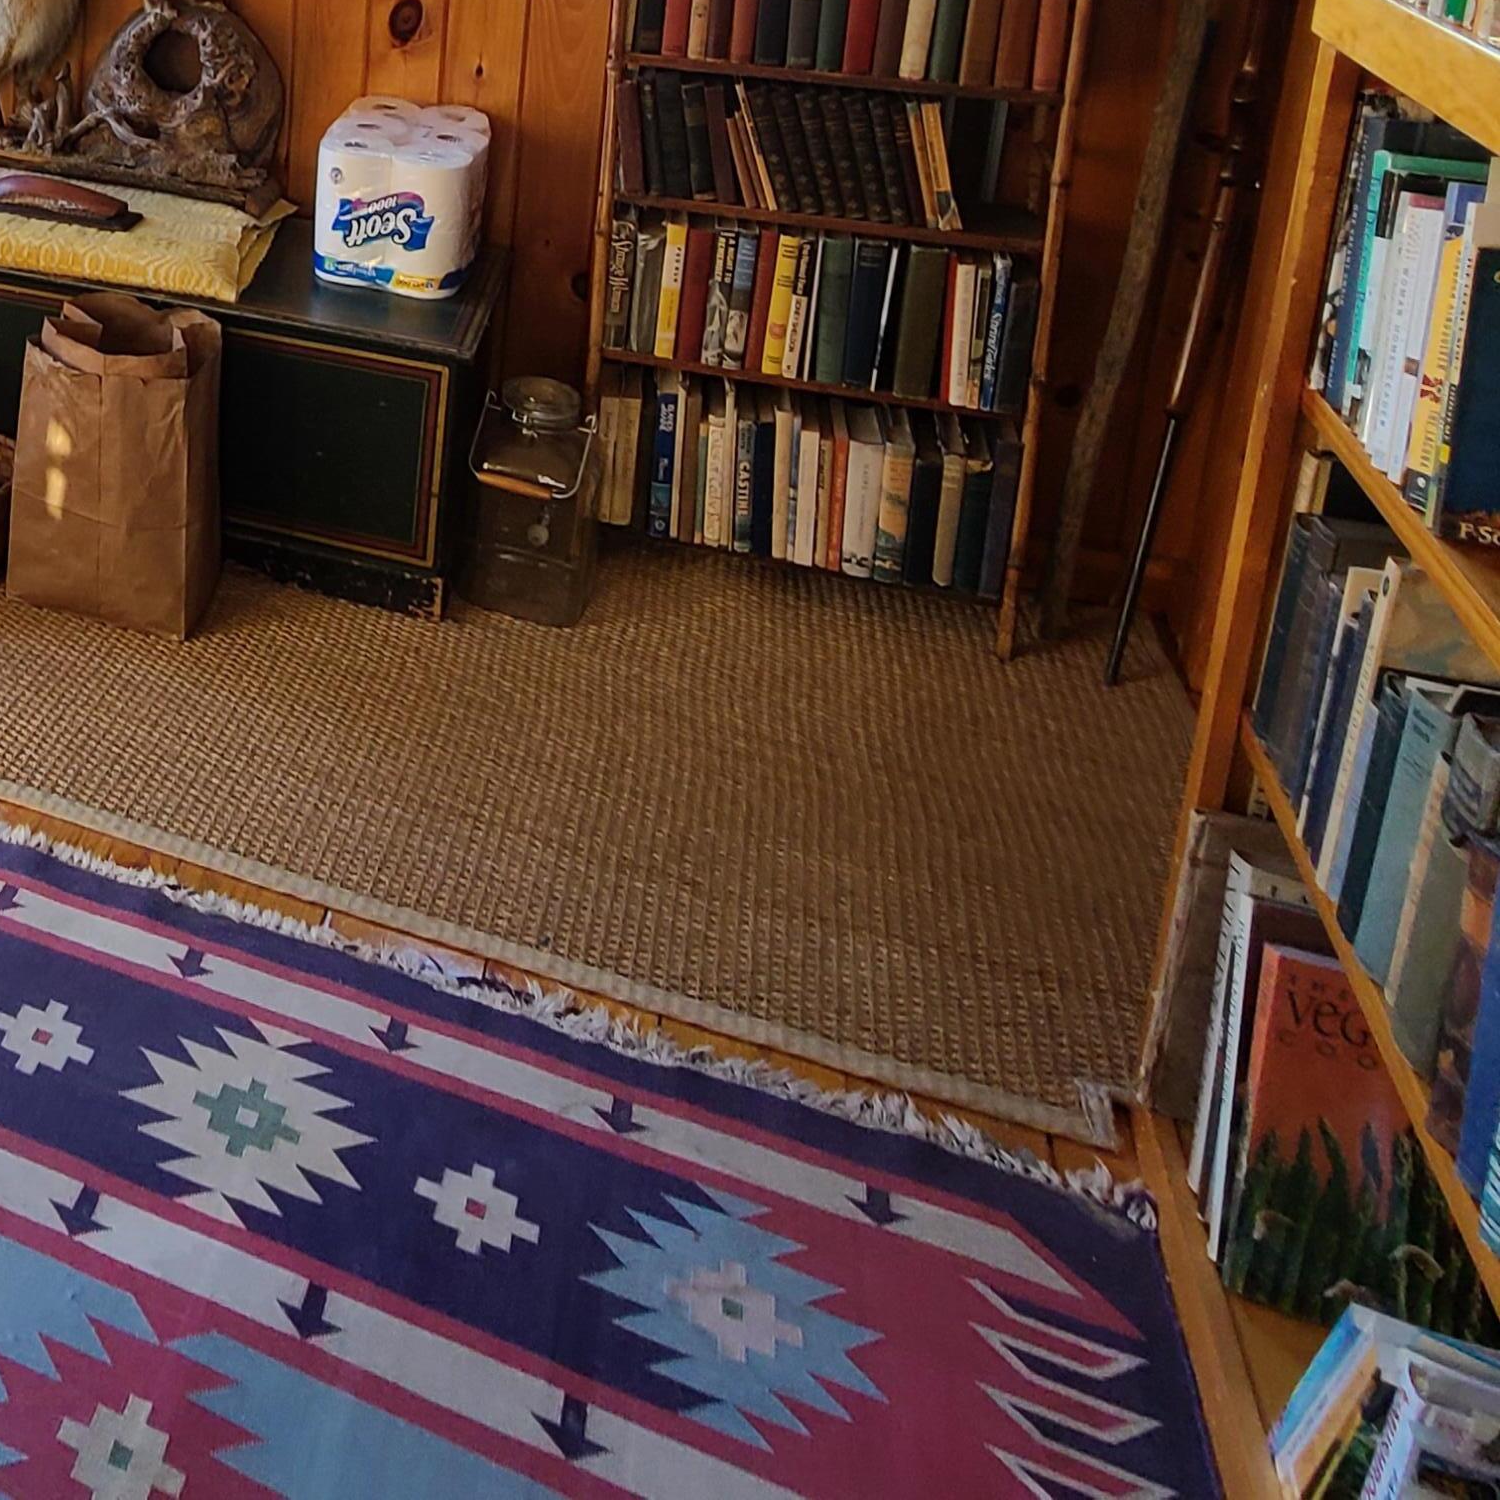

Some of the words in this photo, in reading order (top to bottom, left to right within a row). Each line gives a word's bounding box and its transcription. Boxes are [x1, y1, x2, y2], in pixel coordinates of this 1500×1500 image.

[368, 195, 398, 211] 1000
[346, 207, 418, 248] Scott
[1397, 268, 1410, 316] WOMAN
[1379, 323, 1403, 428] HOMESTEADER
[736, 460, 751, 517] CASTINE
